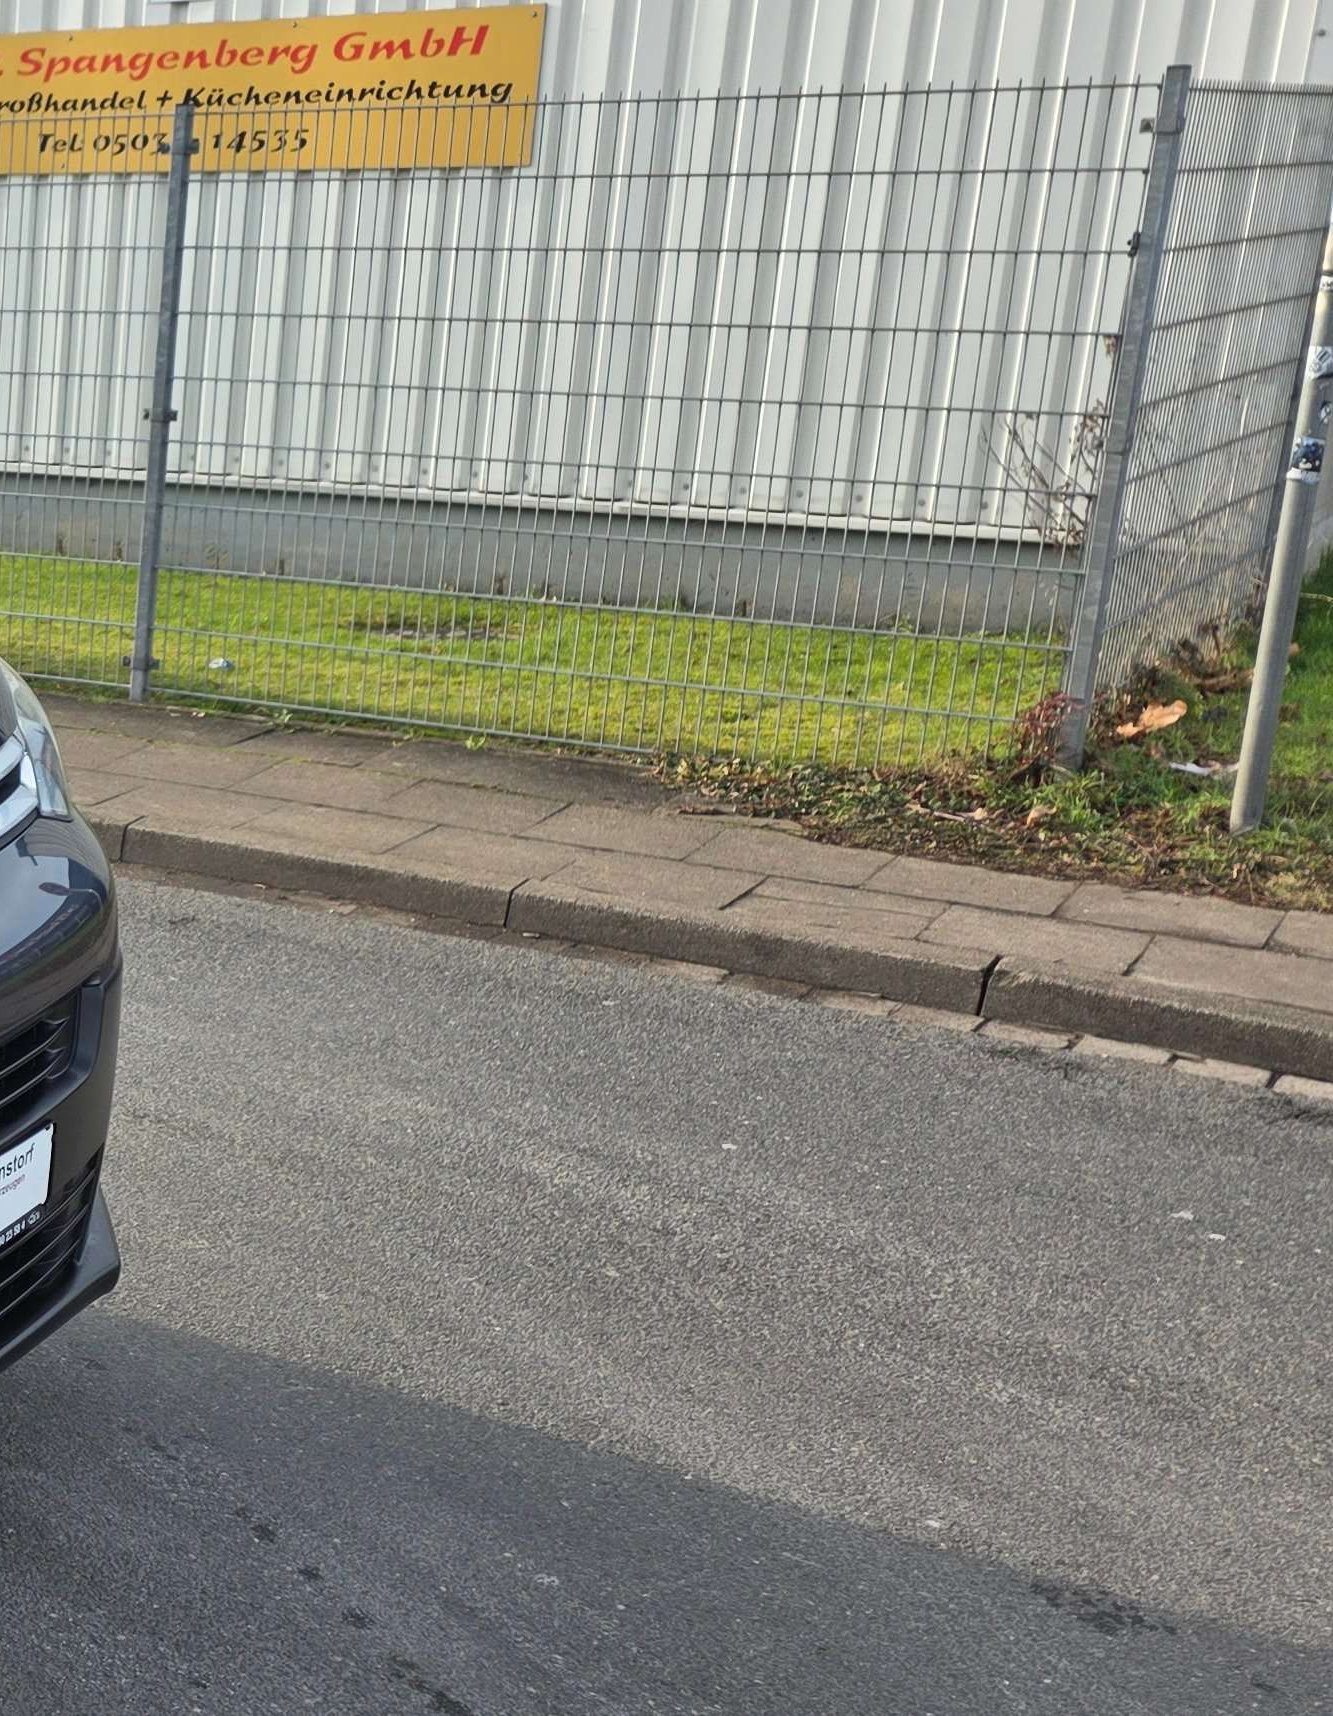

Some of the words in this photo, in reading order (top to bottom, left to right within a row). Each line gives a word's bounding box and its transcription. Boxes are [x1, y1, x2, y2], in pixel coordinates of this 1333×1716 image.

[17, 39, 318, 83] Spangenberg
[333, 24, 490, 62] GmbH
[156, 90, 173, 108] +
[183, 79, 514, 108] Kücheneinrichtung
[212, 129, 310, 154] 14535
